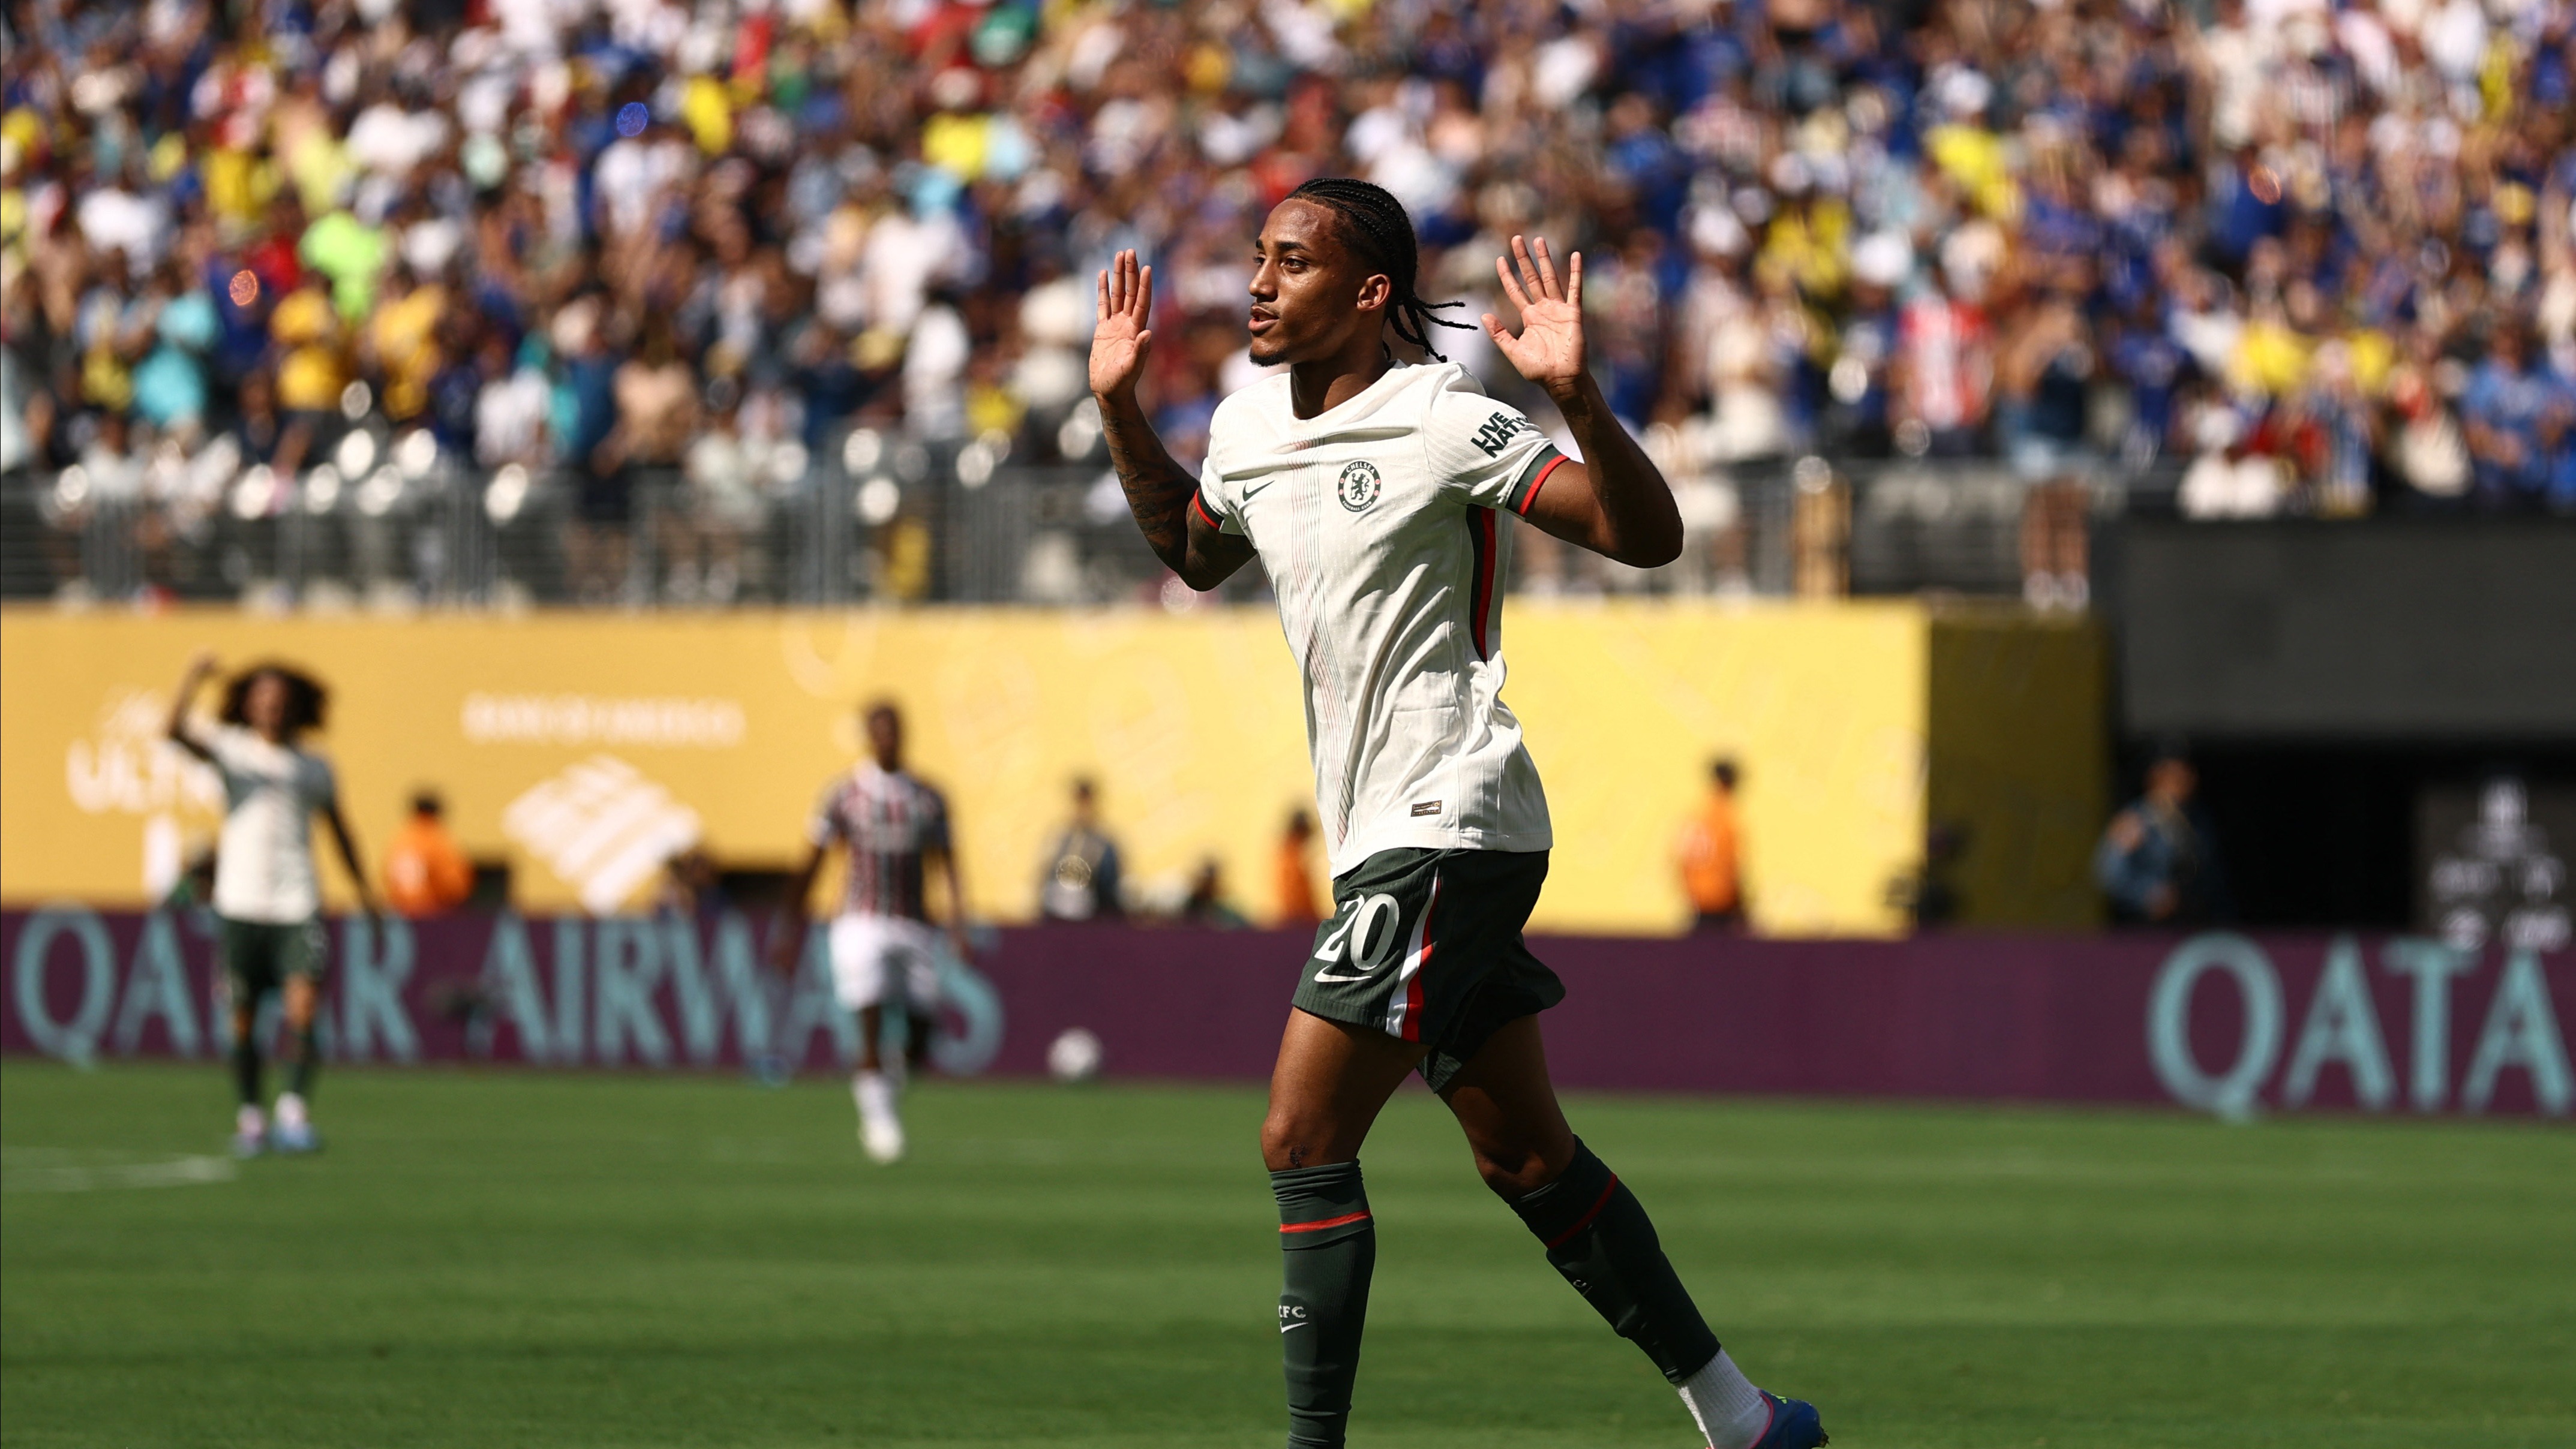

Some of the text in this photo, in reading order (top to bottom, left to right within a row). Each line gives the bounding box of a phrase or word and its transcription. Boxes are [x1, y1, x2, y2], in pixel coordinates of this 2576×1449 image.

[1470, 411, 1509, 450] LIVE
[1483, 417, 1530, 459] NATI
[1346, 462, 1375, 474] CHELSEA
[1314, 893, 1400, 971] 20
[14, 901, 1003, 1075] QAR AIRWAS
[2148, 931, 2575, 1122] QATA
[1278, 1304, 1306, 1318] CFC
